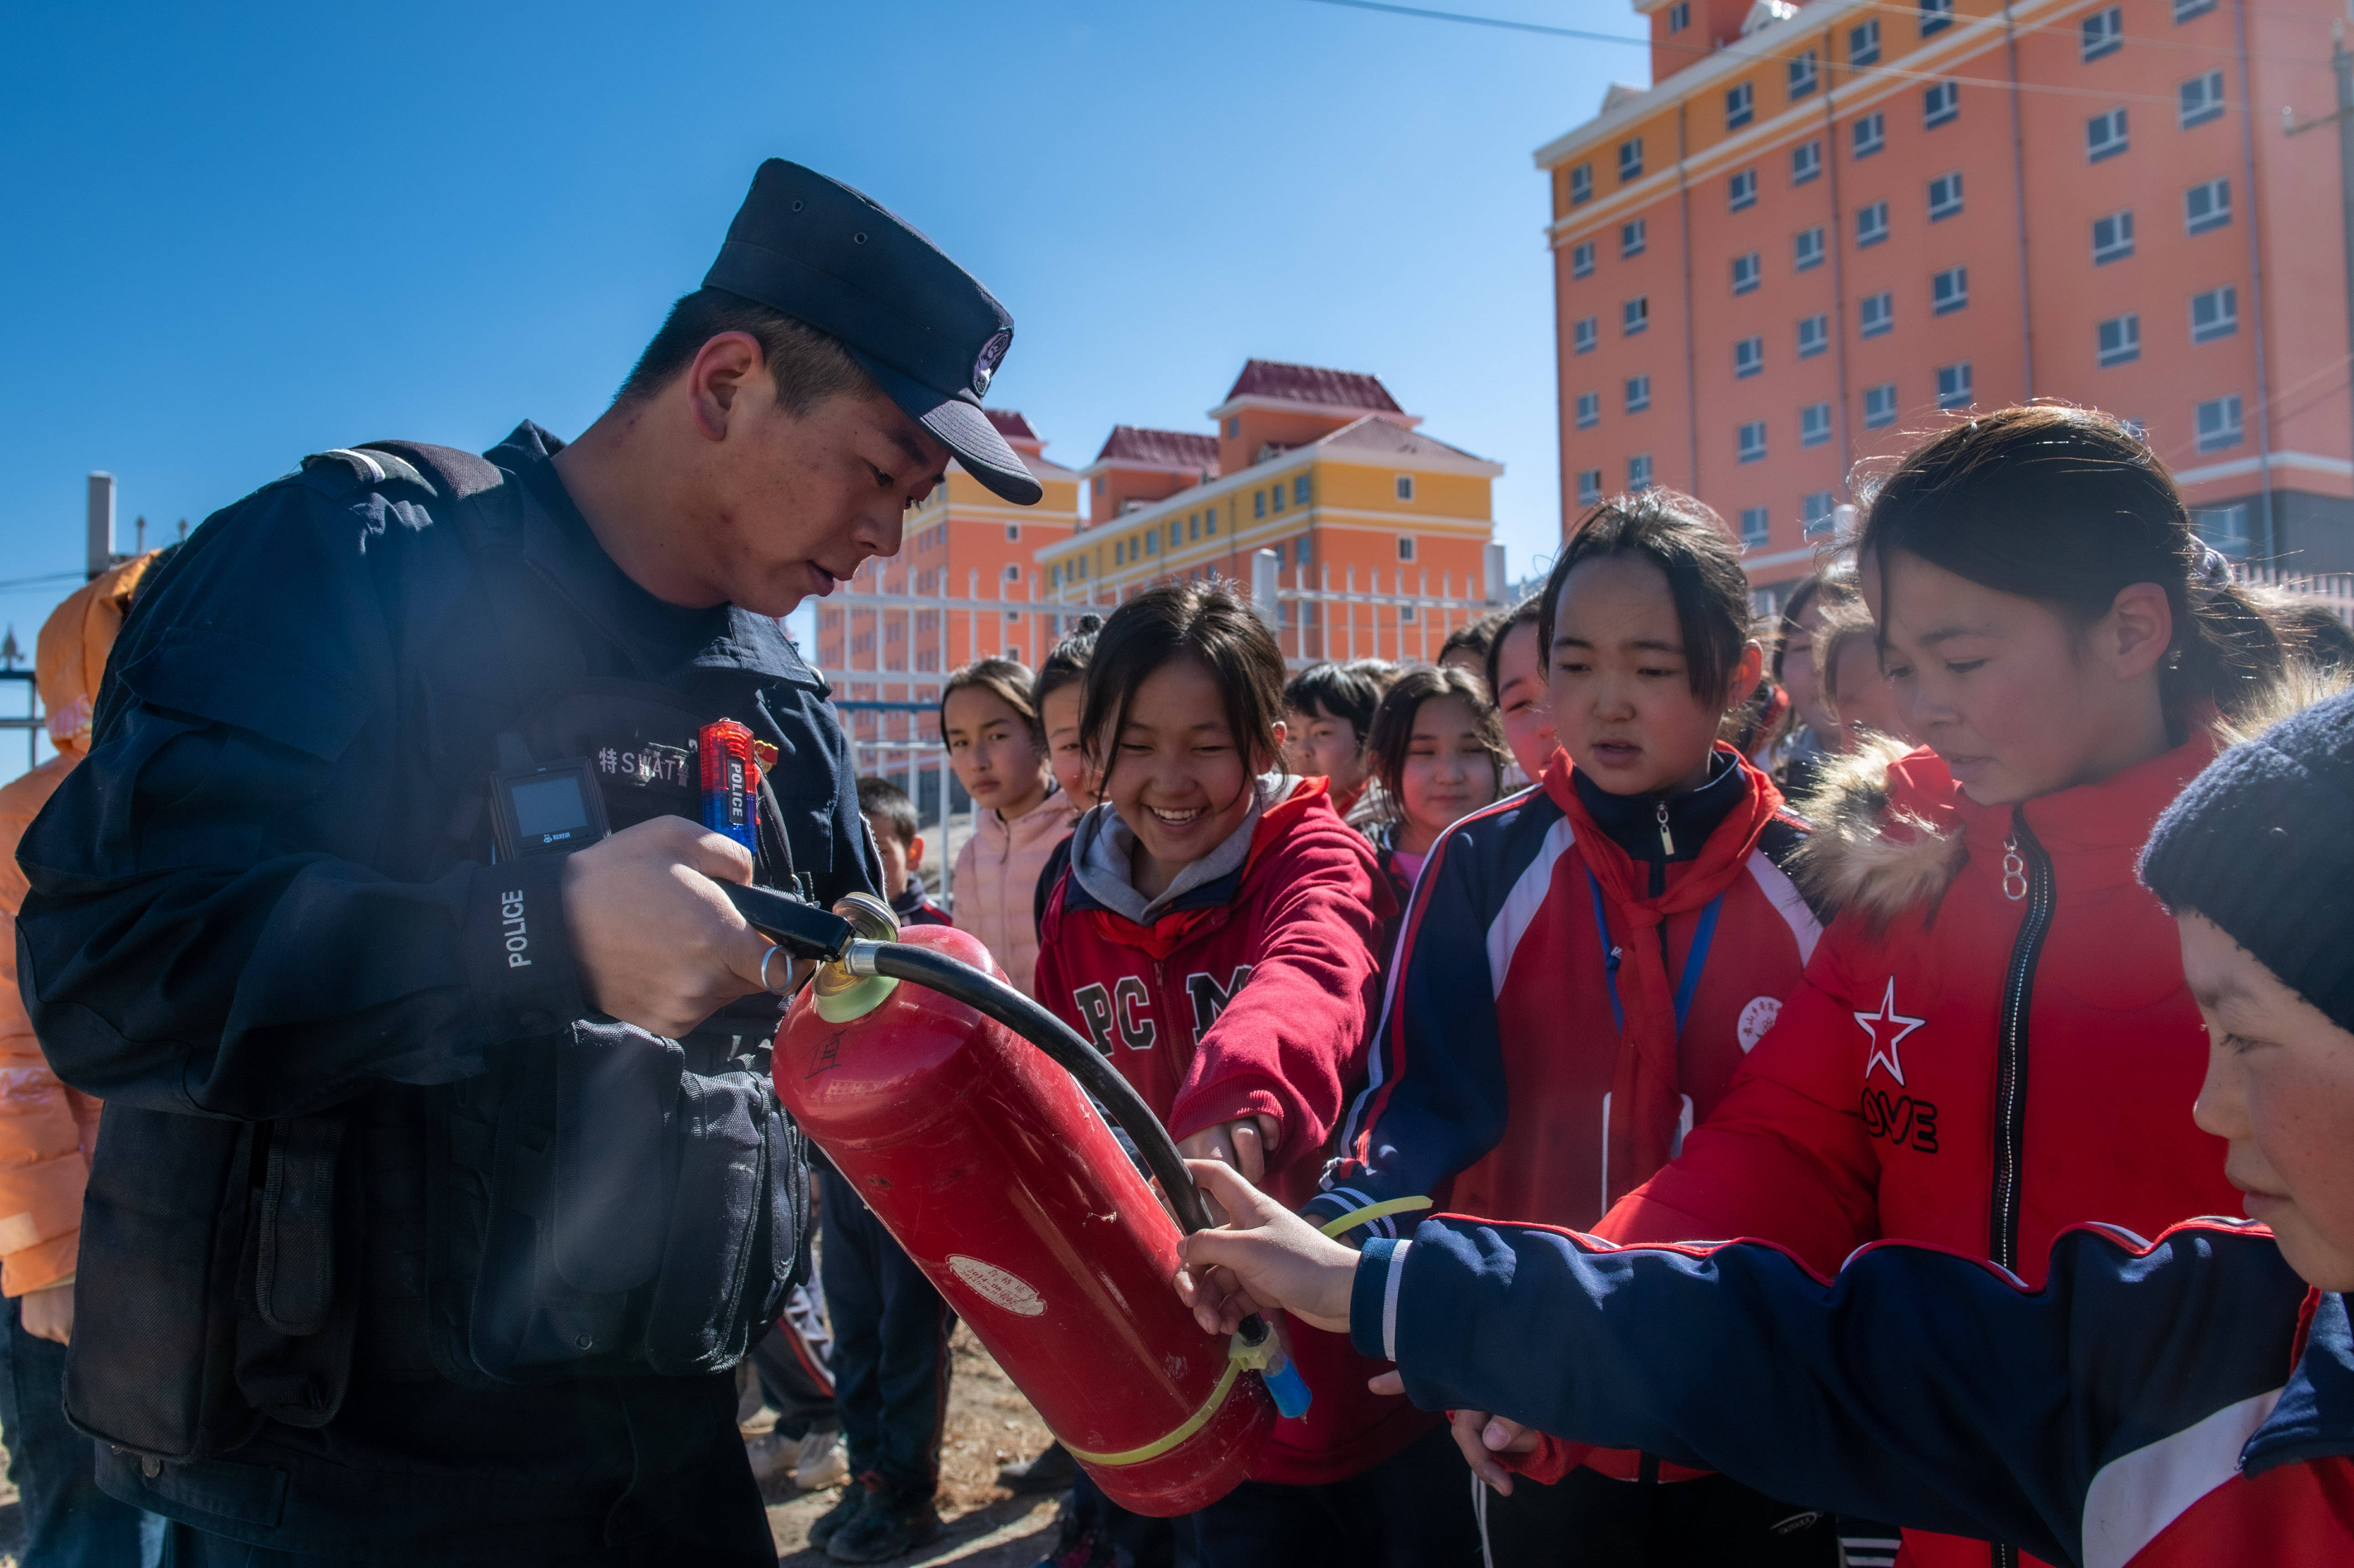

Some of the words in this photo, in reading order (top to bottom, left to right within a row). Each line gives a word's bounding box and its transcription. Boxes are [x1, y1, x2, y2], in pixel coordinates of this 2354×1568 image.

[731, 763, 743, 817] POLICE
[502, 890, 532, 968] POLICE
[1073, 975, 1156, 1058] PC
[987, 1269, 1028, 1294] 合格证
